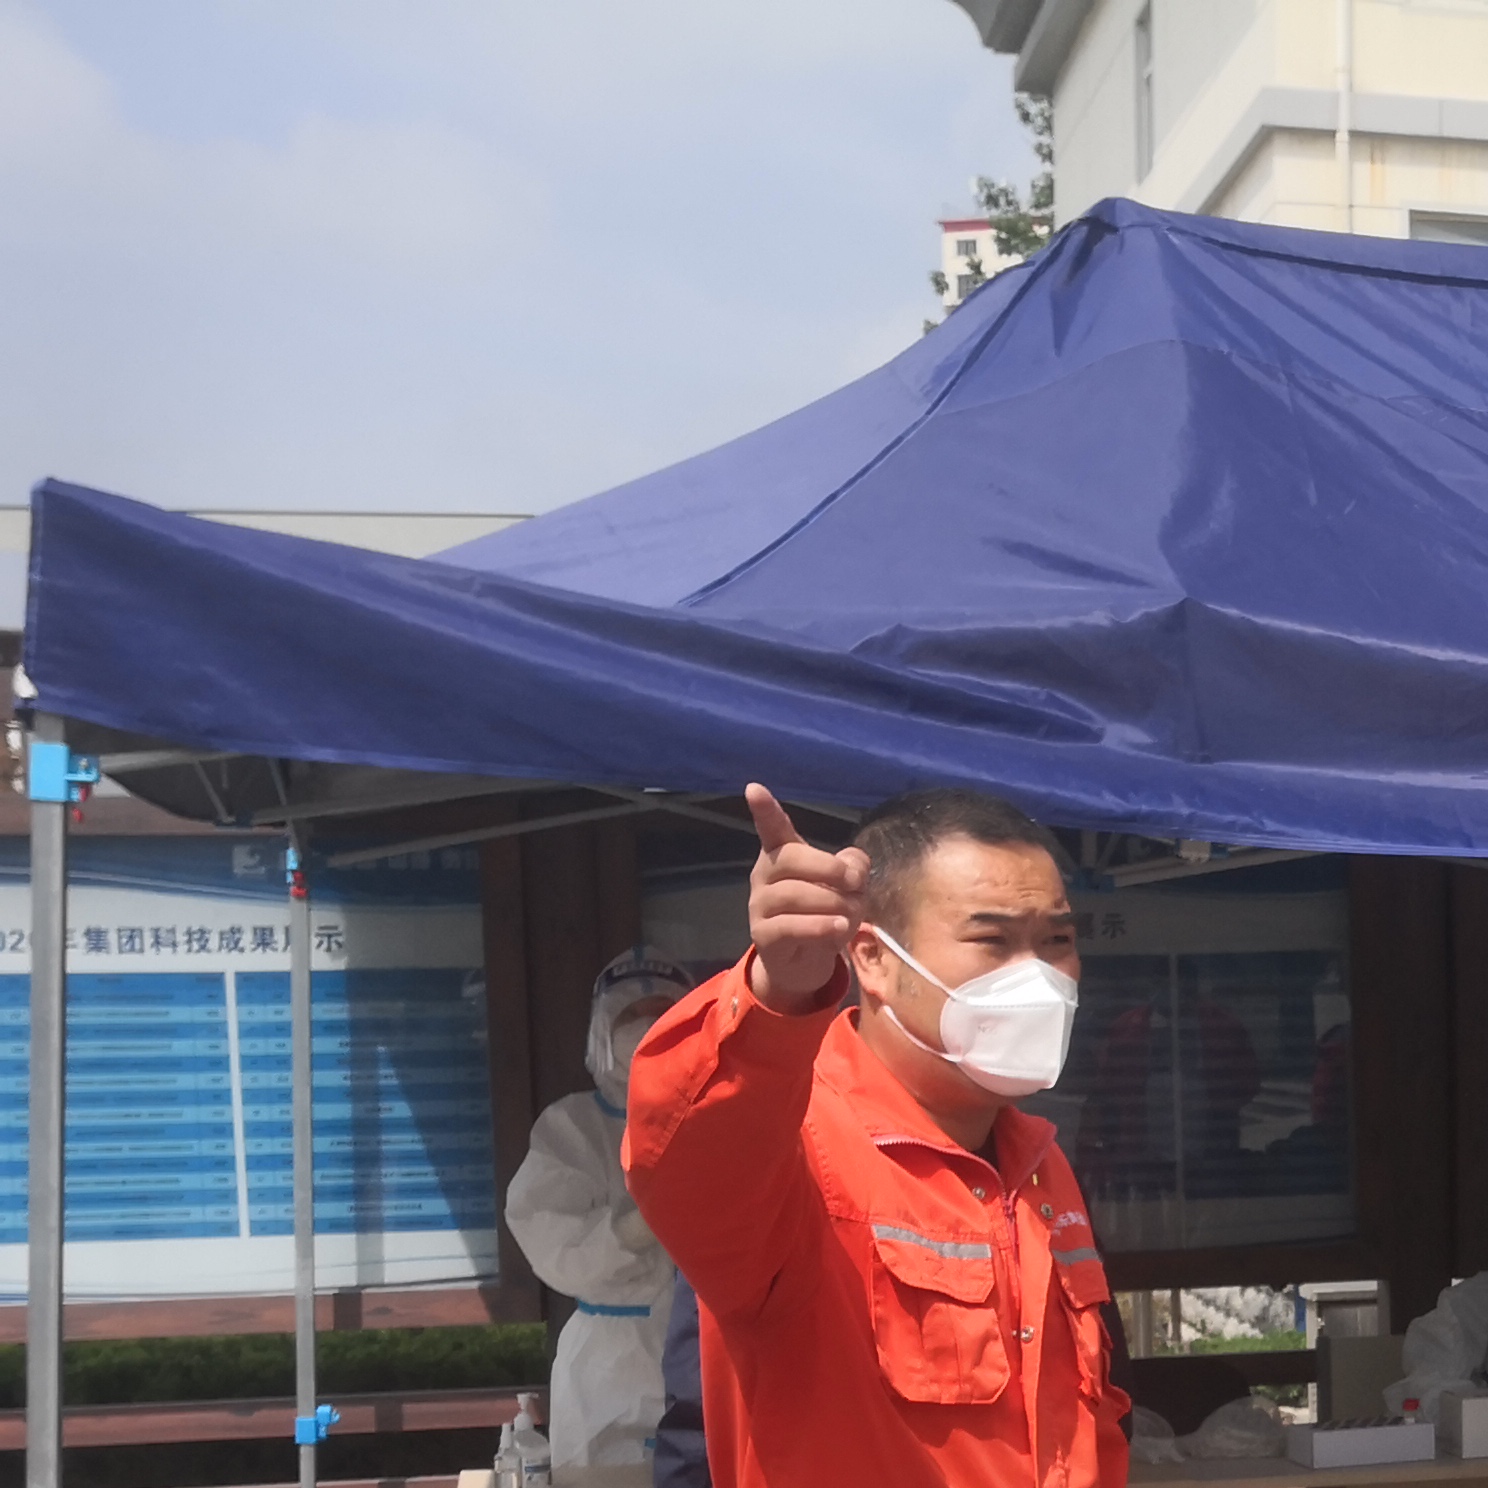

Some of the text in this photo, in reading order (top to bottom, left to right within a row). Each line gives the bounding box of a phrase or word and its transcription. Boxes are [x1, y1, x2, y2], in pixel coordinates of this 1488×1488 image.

[0, 925, 343, 954] 2集团科技成果示
